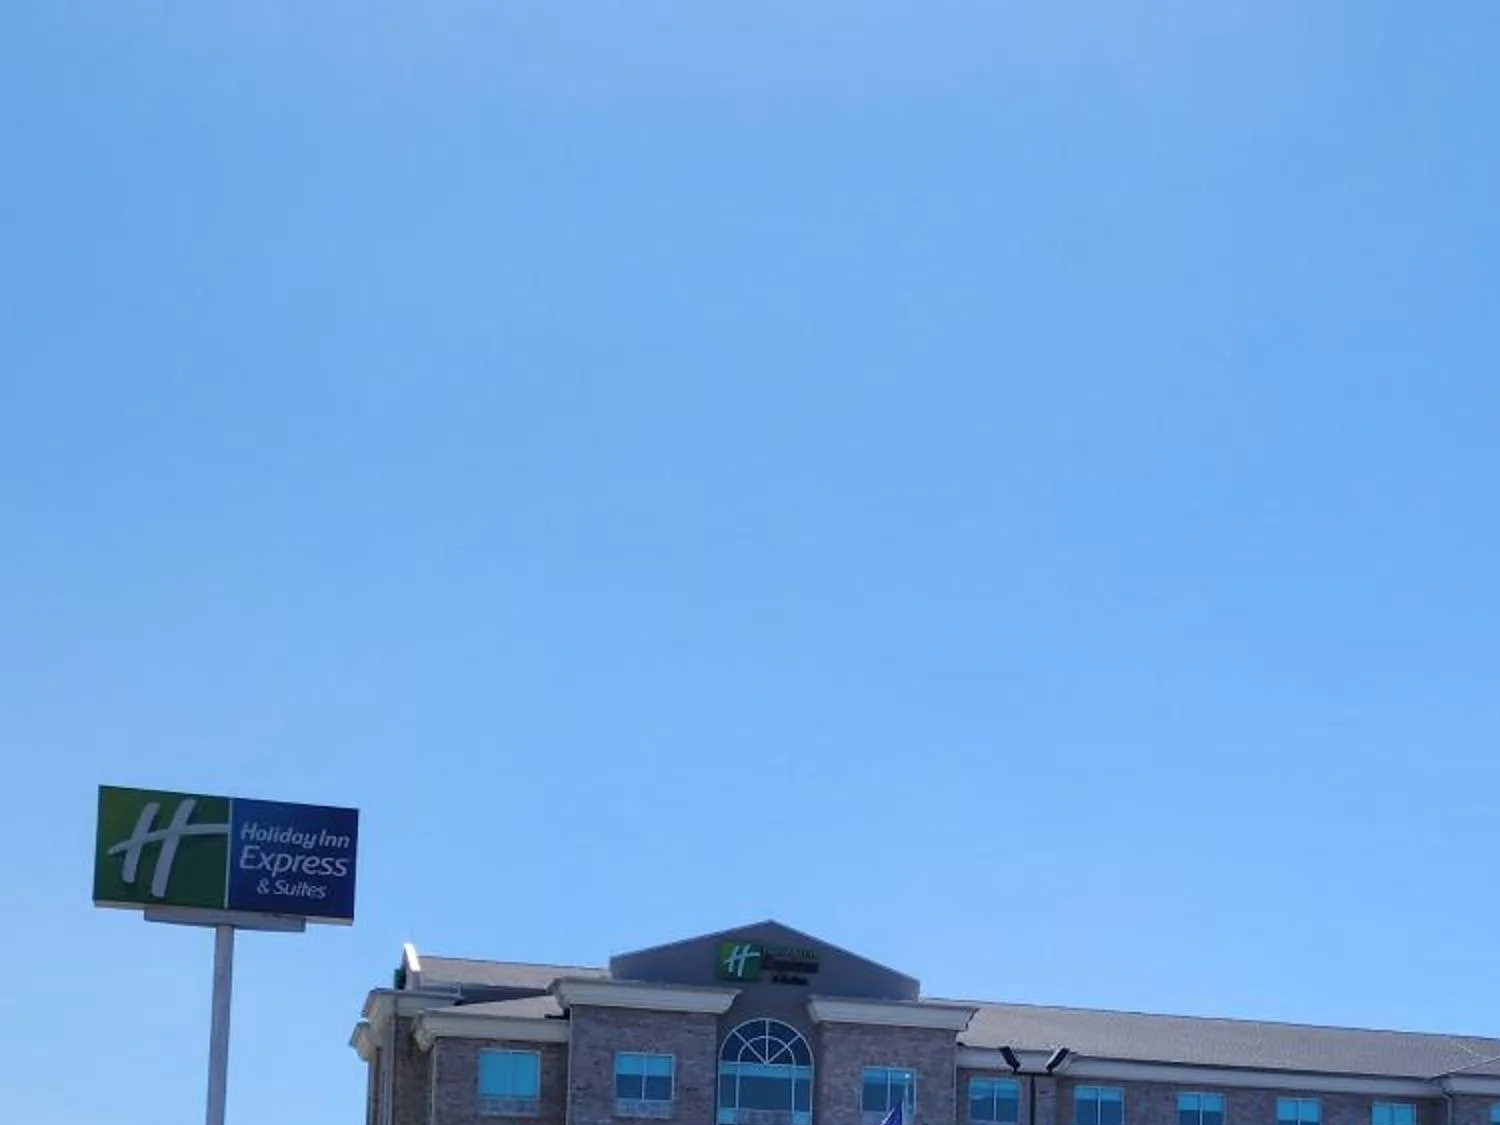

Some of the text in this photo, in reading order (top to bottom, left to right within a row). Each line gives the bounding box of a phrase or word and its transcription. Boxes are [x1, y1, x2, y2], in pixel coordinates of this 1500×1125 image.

[241, 822, 351, 849] Holiday Inn
[240, 845, 349, 878] Express
[256, 878, 327, 899] & Suites
